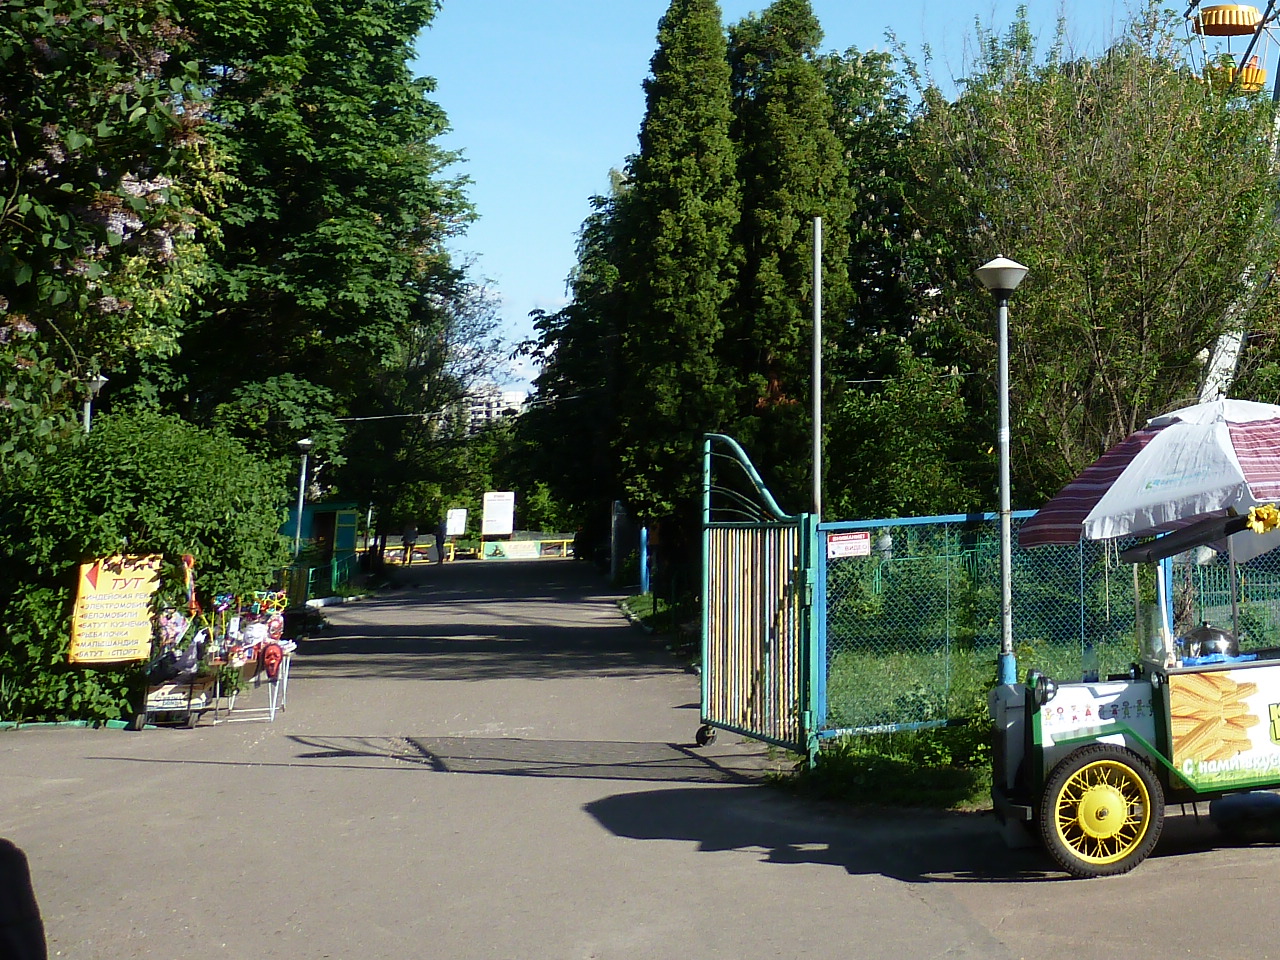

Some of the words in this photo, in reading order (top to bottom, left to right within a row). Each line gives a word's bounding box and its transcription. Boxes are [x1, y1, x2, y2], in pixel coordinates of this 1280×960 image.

[112, 577, 145, 590] ТУТ
[85, 593, 133, 601] ИНДЕЙСКАЯ
[82, 621, 108, 629] БАТУТ
[80, 639, 139, 647] МАЛЫШАНДИЯ
[1198, 755, 1241, 774] нами
